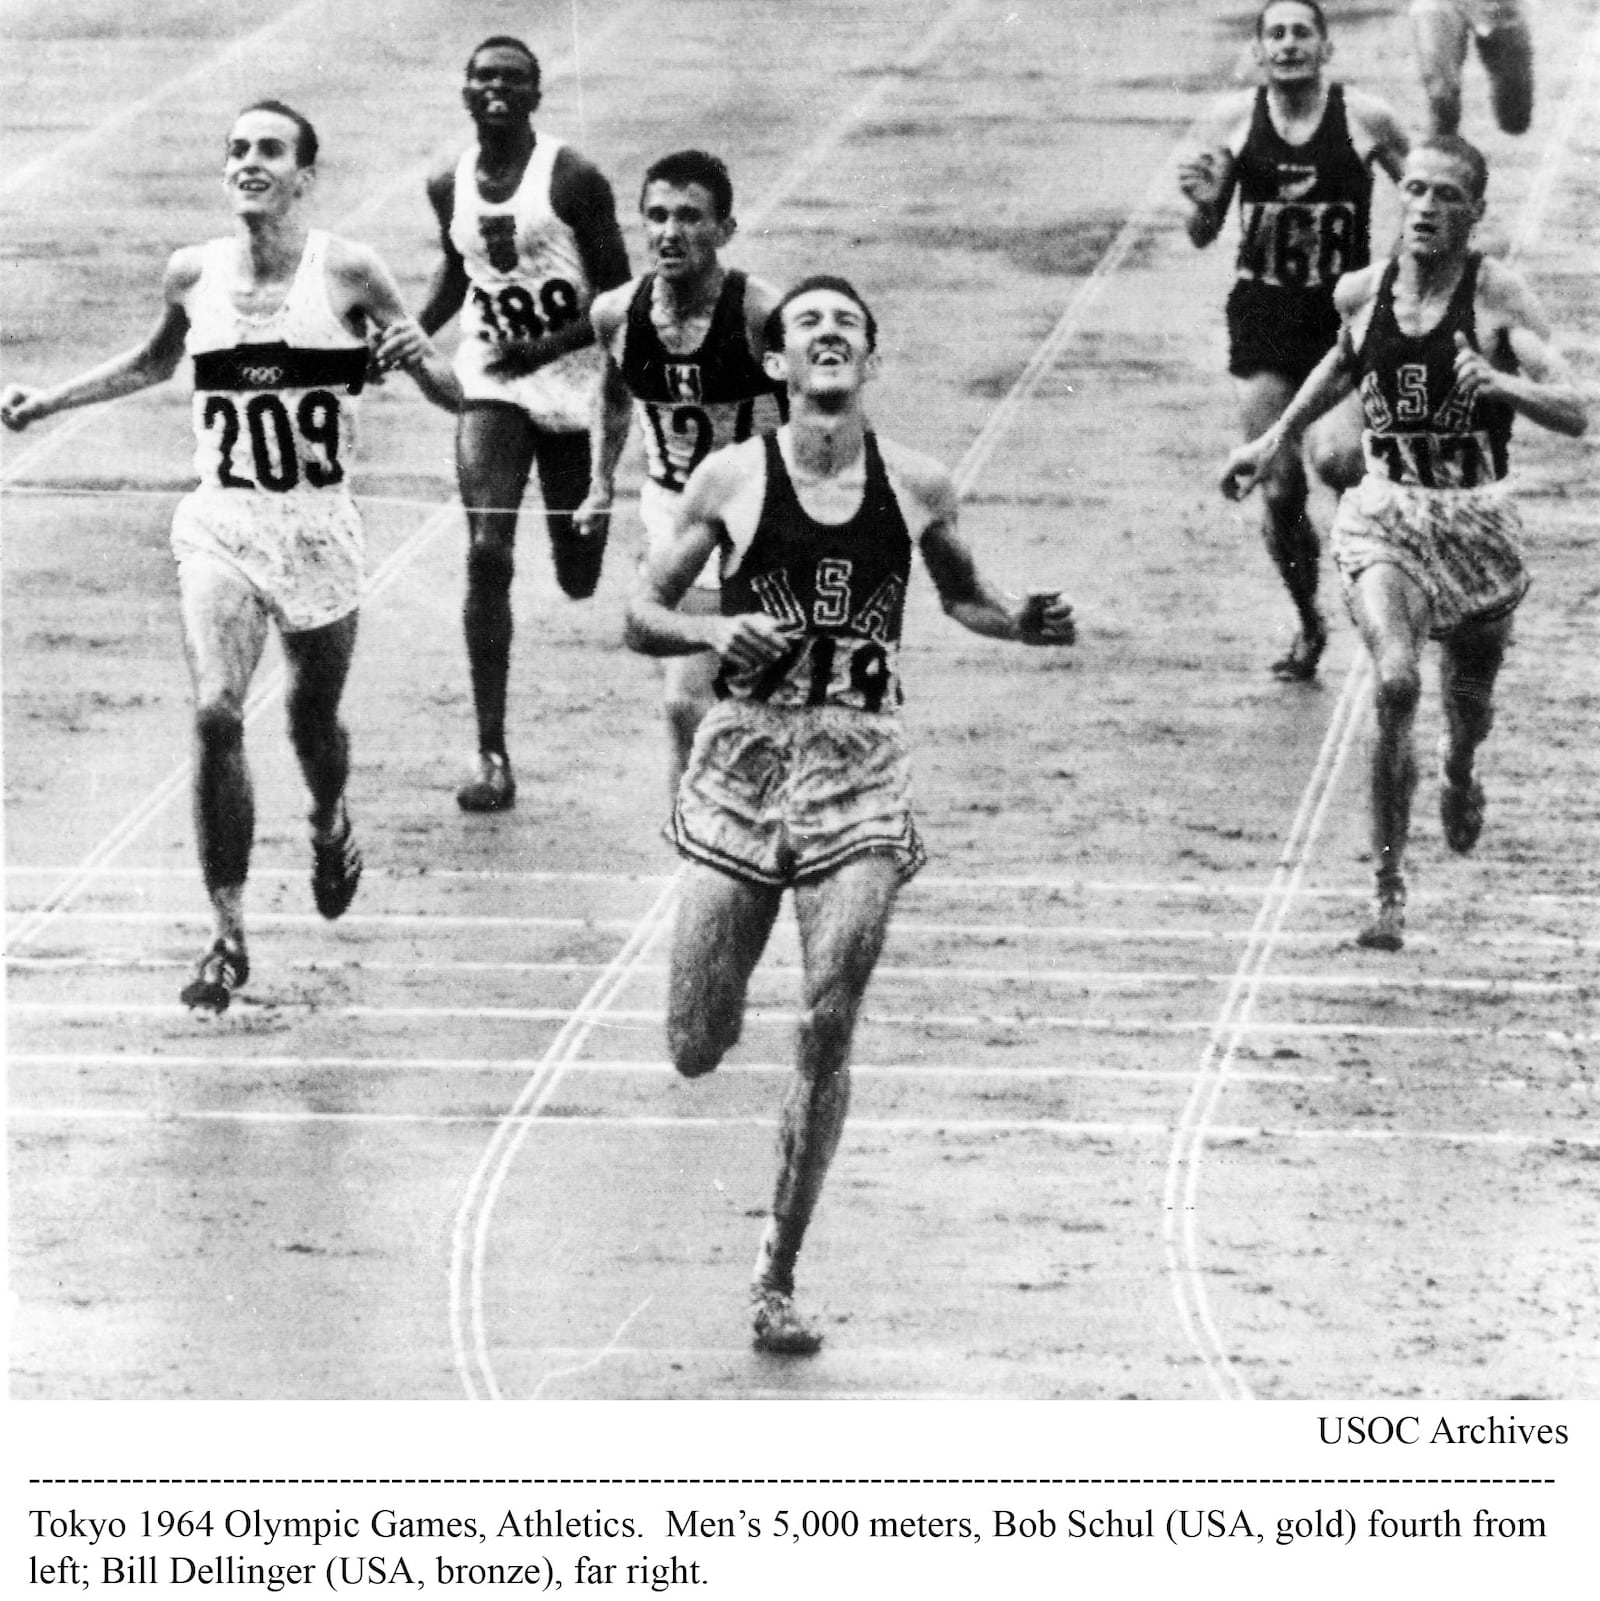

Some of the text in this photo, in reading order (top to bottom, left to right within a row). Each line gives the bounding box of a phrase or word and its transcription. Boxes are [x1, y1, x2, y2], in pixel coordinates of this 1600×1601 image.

[1361, 364, 1479, 432] USA
[203, 389, 345, 493] 209
[1370, 436, 1481, 489] 717
[750, 557, 902, 643] USA
